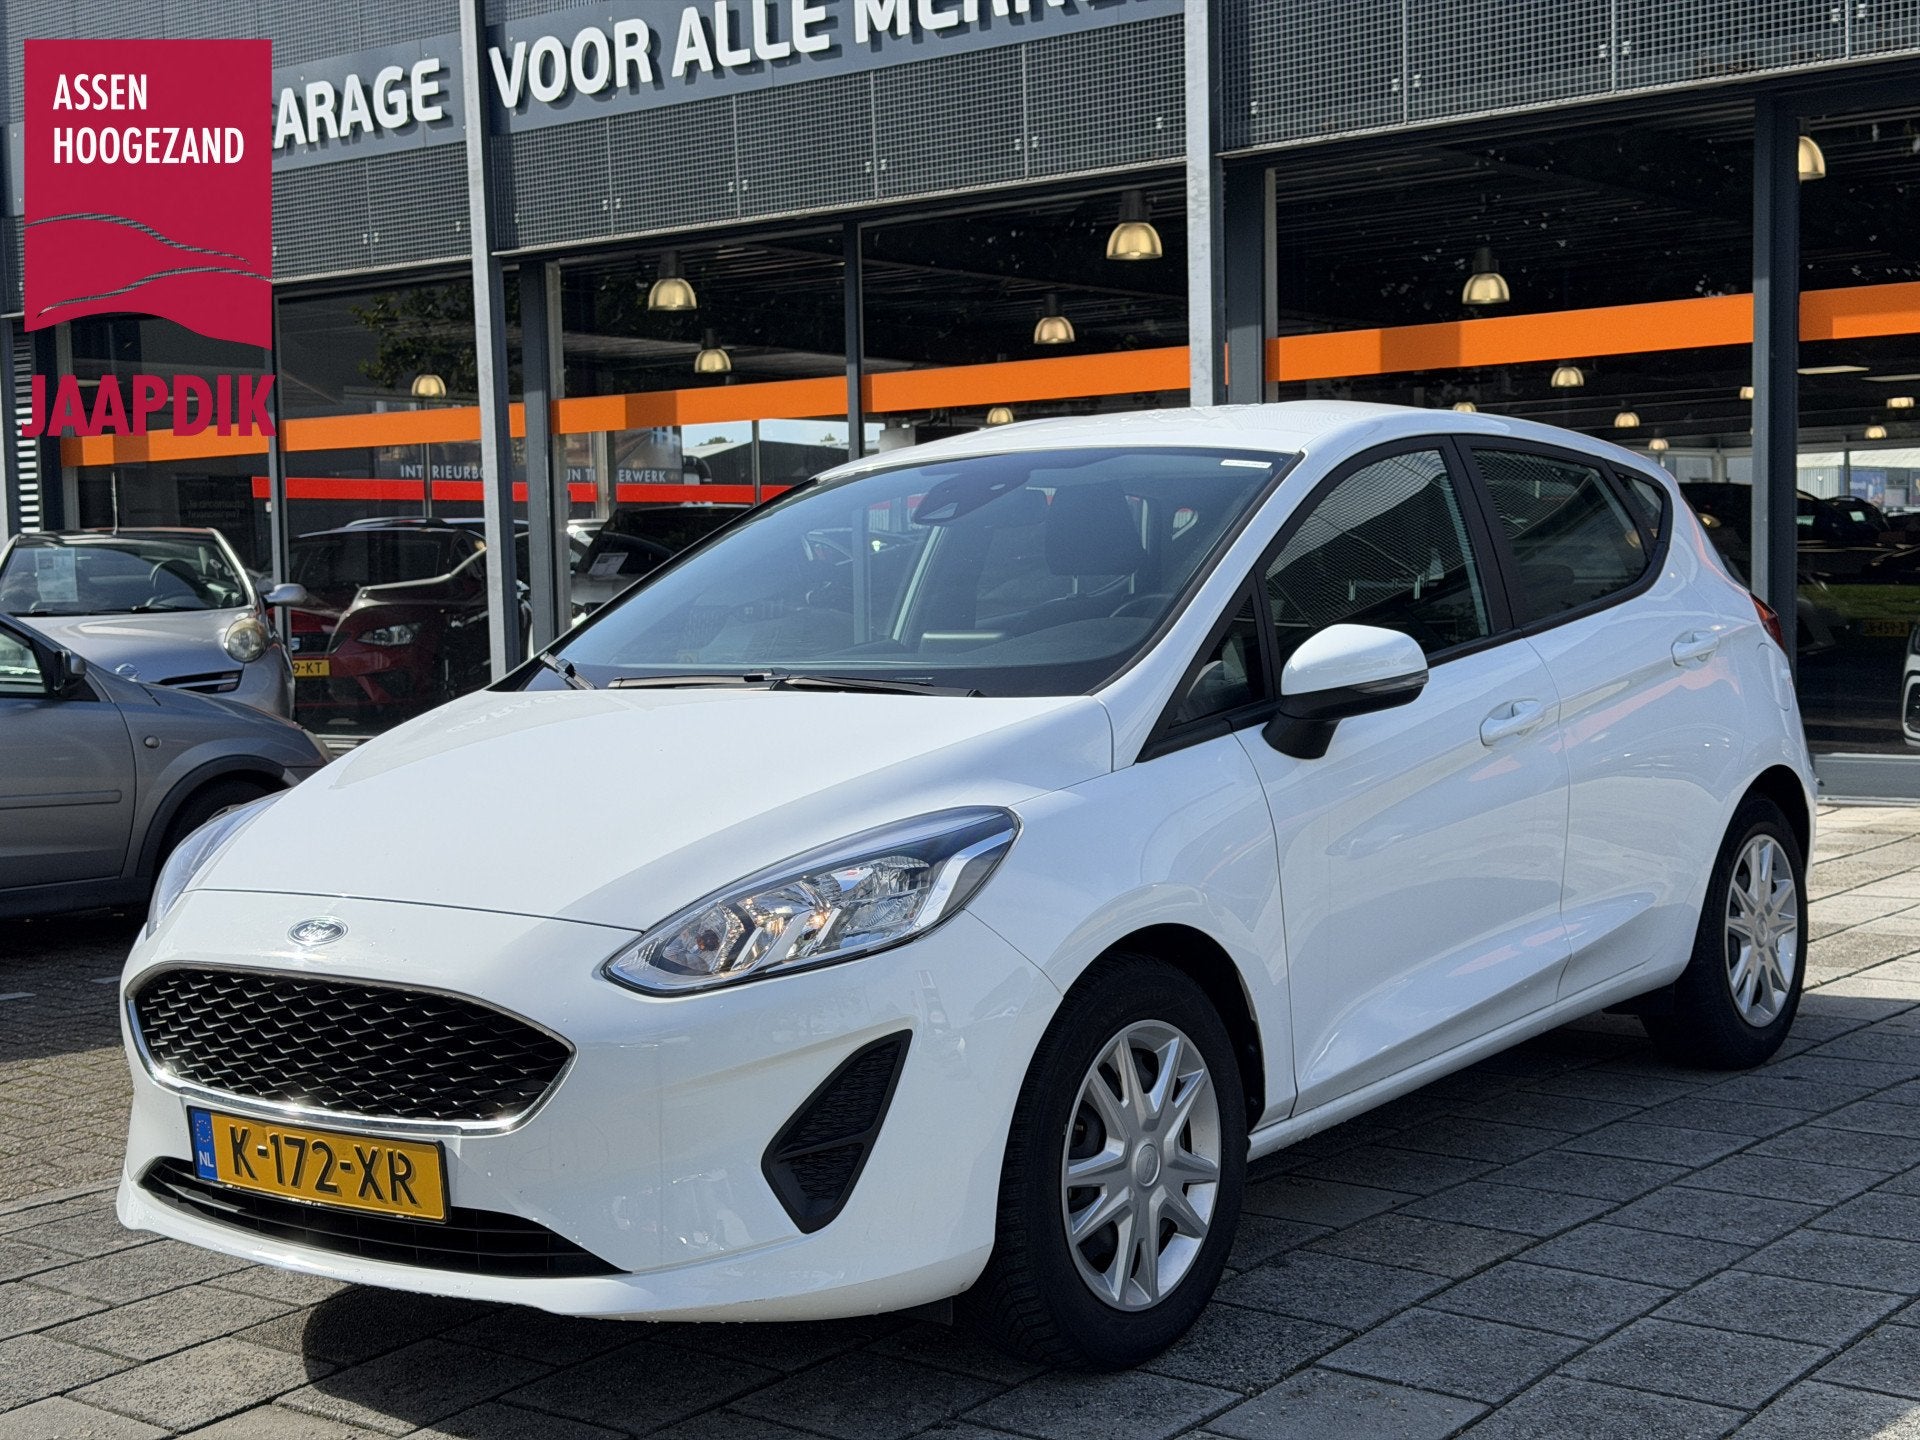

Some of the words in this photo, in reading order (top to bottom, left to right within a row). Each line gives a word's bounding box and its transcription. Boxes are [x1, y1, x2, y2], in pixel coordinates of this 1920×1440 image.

[272, 57, 444, 149] ARAGE
[488, 18, 653, 109] VOOR
[671, 0, 830, 78] ALLE
[199, 1151, 214, 1168] NL
[229, 1124, 419, 1206] K-172-XR
